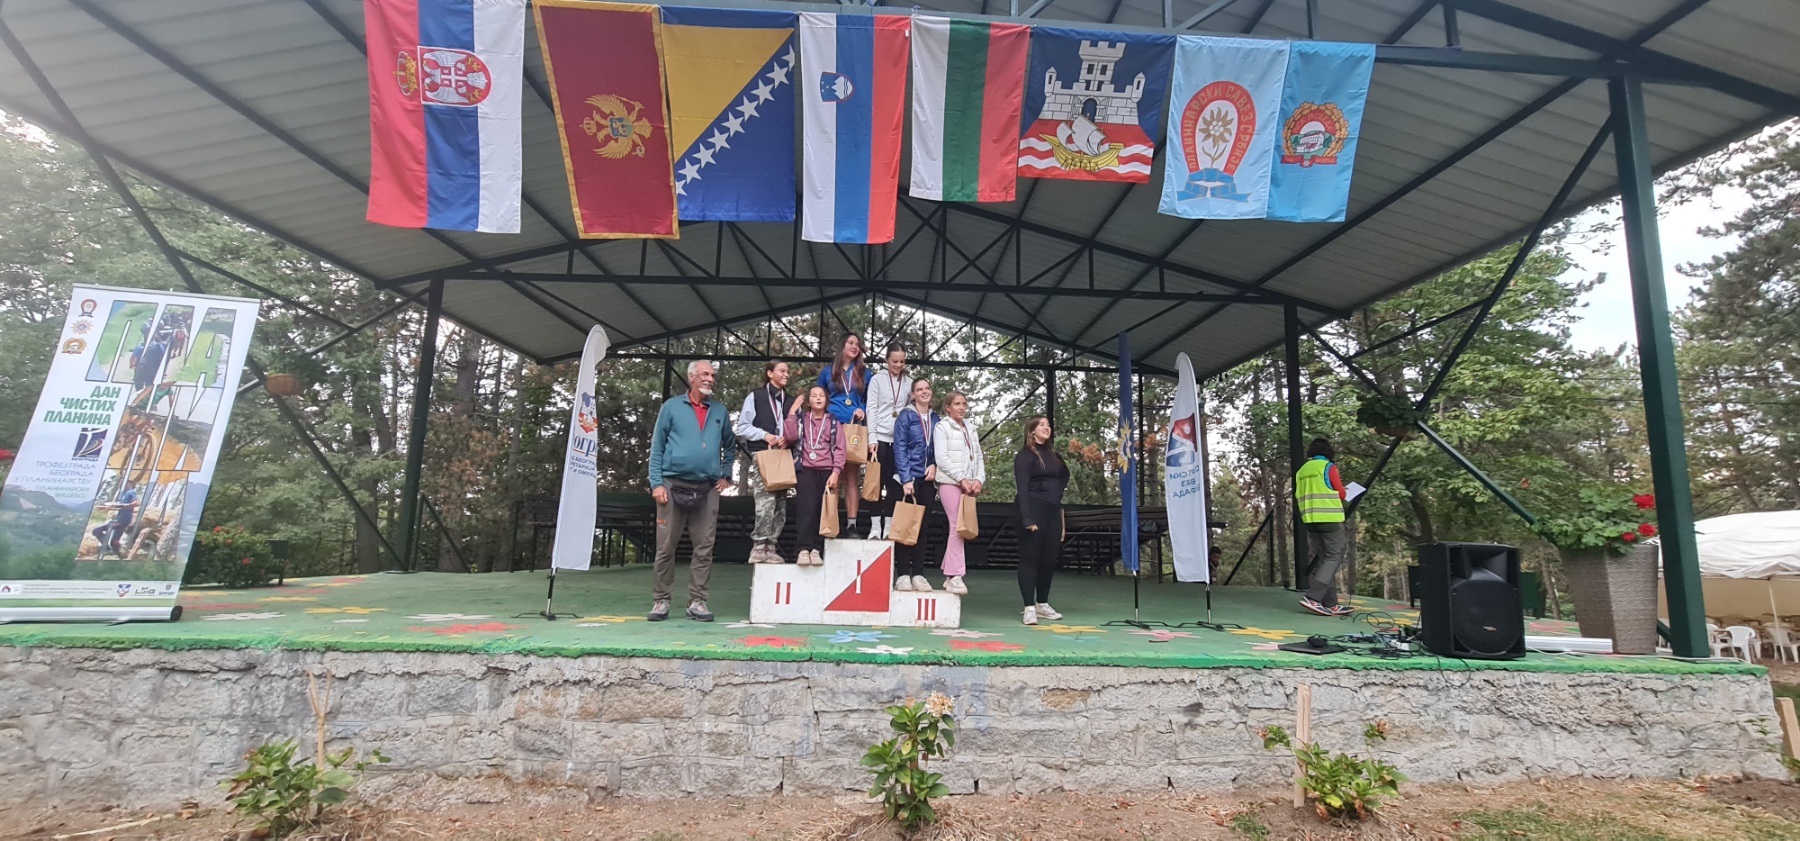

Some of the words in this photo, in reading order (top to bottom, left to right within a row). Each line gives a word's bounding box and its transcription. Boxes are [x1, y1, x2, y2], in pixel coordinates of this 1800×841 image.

[1183, 84, 1222, 169] ПЛАНИНАРСКИ
[1225, 85, 1254, 122] САВЕЗ
[90, 385, 121, 399] ДАН
[60, 397, 117, 412] ЧИСТИХ
[43, 410, 111, 425] ПЛАНИНА
[21, 475, 91, 484] ПЛАНИНАРСТВУ
[50, 469, 93, 477] БЕОГРАДА
[775, 582, 791, 605] II
[917, 598, 936, 621] III
